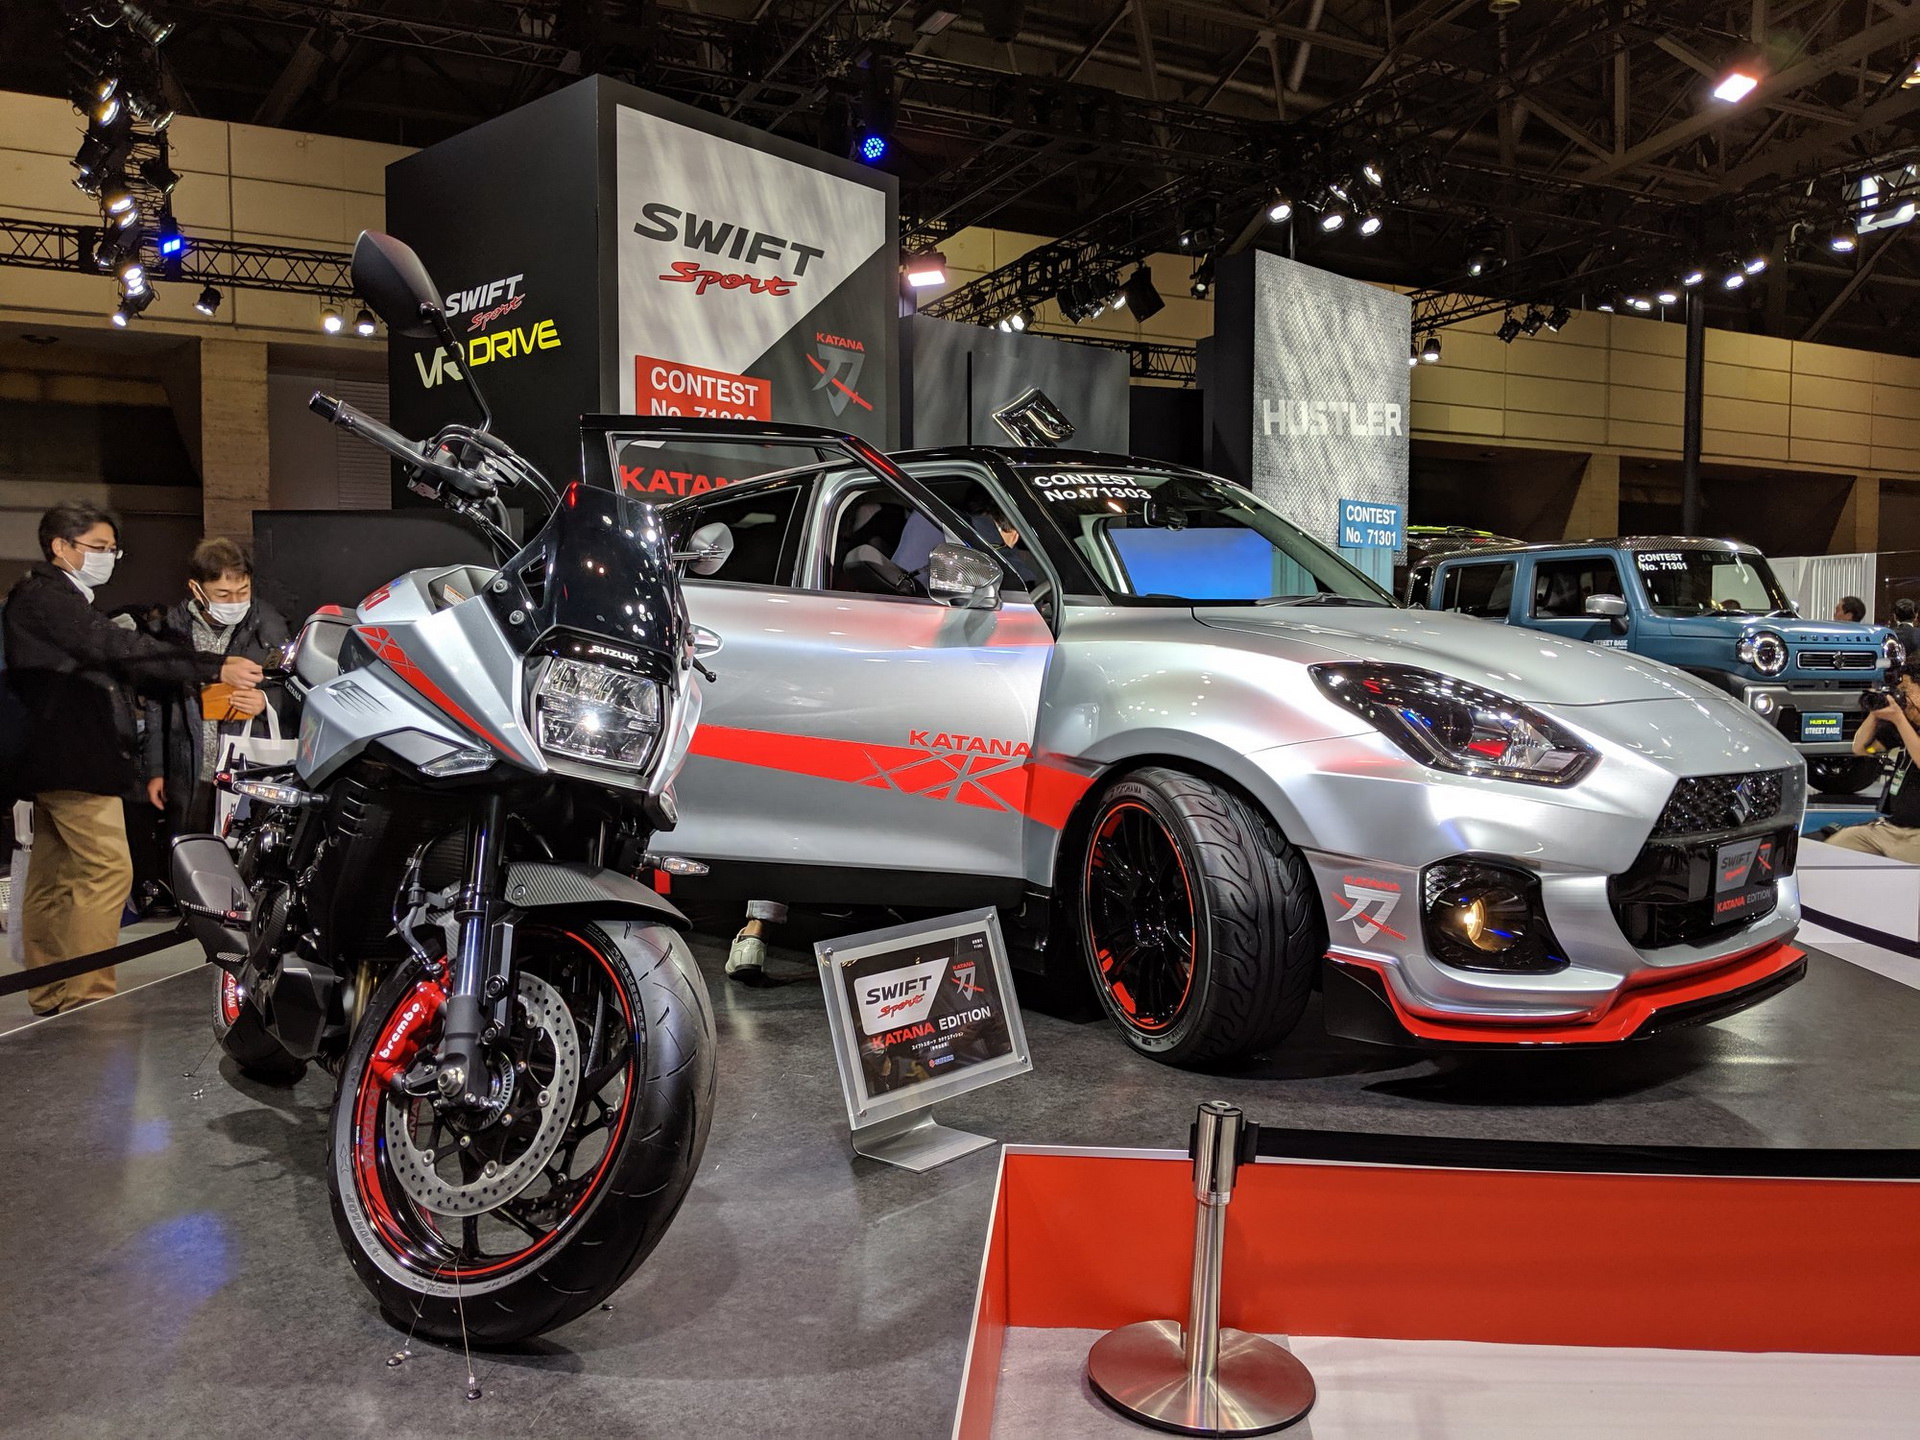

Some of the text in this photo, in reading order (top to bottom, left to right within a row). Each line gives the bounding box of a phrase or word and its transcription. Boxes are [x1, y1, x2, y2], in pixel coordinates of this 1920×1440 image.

[633, 202, 825, 277] SWIFT
[659, 261, 798, 296] Sport
[445, 273, 524, 318] SWIFT
[466, 293, 526, 332] Sport
[469, 319, 562, 367] DRIVE
[816, 332, 865, 352] KATANA
[650, 366, 759, 407] CONTEST
[1263, 399, 1403, 437] HUSTLER
[1034, 474, 1138, 488] CONTEST
[1085, 487, 1152, 500] 71303
[1346, 504, 1397, 526] CONTEST
[1346, 526, 1396, 546] No. 71301
[1637, 553, 1683, 562] CONTEST
[1641, 562, 1688, 571] No. 71301
[591, 645, 640, 664] SUZUKI
[908, 729, 1034, 759] KATANA
[1805, 726, 1825, 735] STREET
[1720, 851, 1753, 870] SWIFT
[1716, 888, 1772, 913] KATANA EDITION
[865, 975, 932, 1006] SWIFT
[877, 993, 925, 1019] Sport
[379, 1003, 420, 1059] brembo
[872, 1022, 936, 1050] KATANA
[938, 1006, 992, 1031] EDITION
[362, 1087, 381, 1170] KATANA
